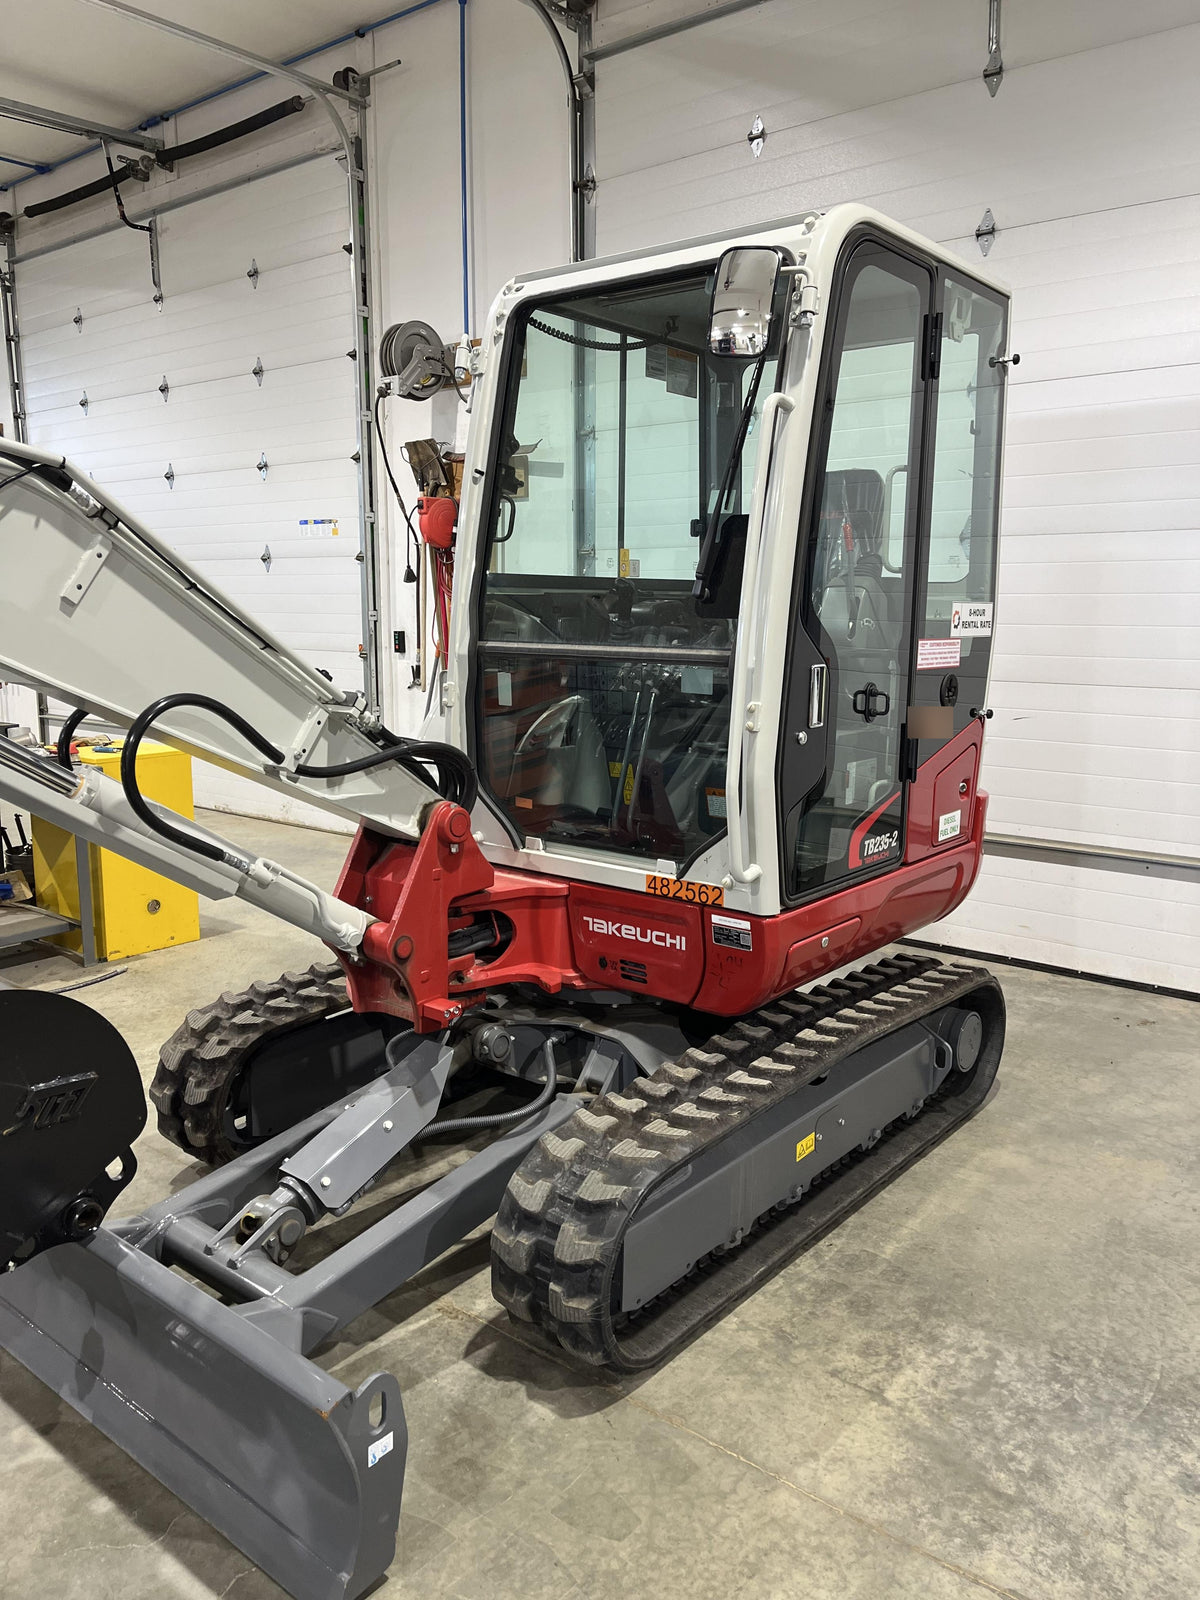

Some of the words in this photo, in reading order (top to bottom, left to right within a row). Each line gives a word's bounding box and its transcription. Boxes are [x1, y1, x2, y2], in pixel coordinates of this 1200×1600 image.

[864, 830, 898, 856] TB235-2
[940, 828, 949, 837] FUEL
[949, 825, 958, 833] ONLY
[647, 875, 723, 906] 482562
[583, 916, 686, 951] TAKEUCHI
